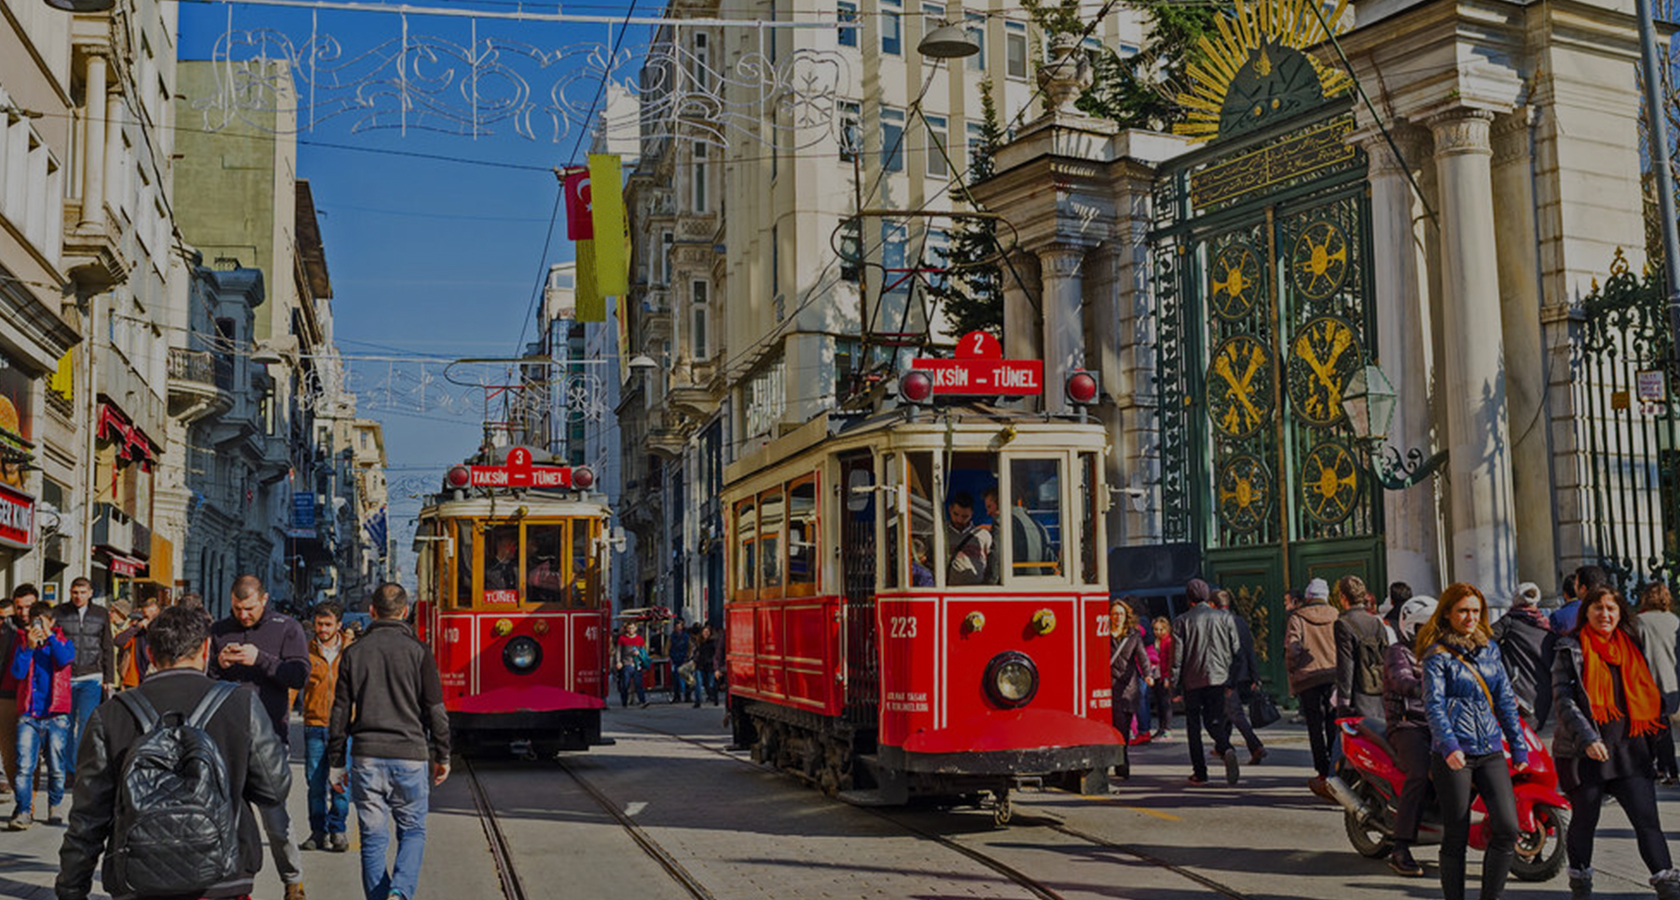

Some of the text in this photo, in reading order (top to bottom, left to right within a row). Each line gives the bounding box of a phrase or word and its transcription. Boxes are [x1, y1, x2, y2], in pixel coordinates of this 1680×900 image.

[973, 333, 984, 354] 2
[920, 365, 968, 386] KSİM
[992, 366, 1038, 387] TÜNEL
[515, 450, 524, 465] 3
[473, 469, 508, 485] TAKSİM
[531, 470, 565, 485] TÜNEL
[890, 616, 917, 638] 223
